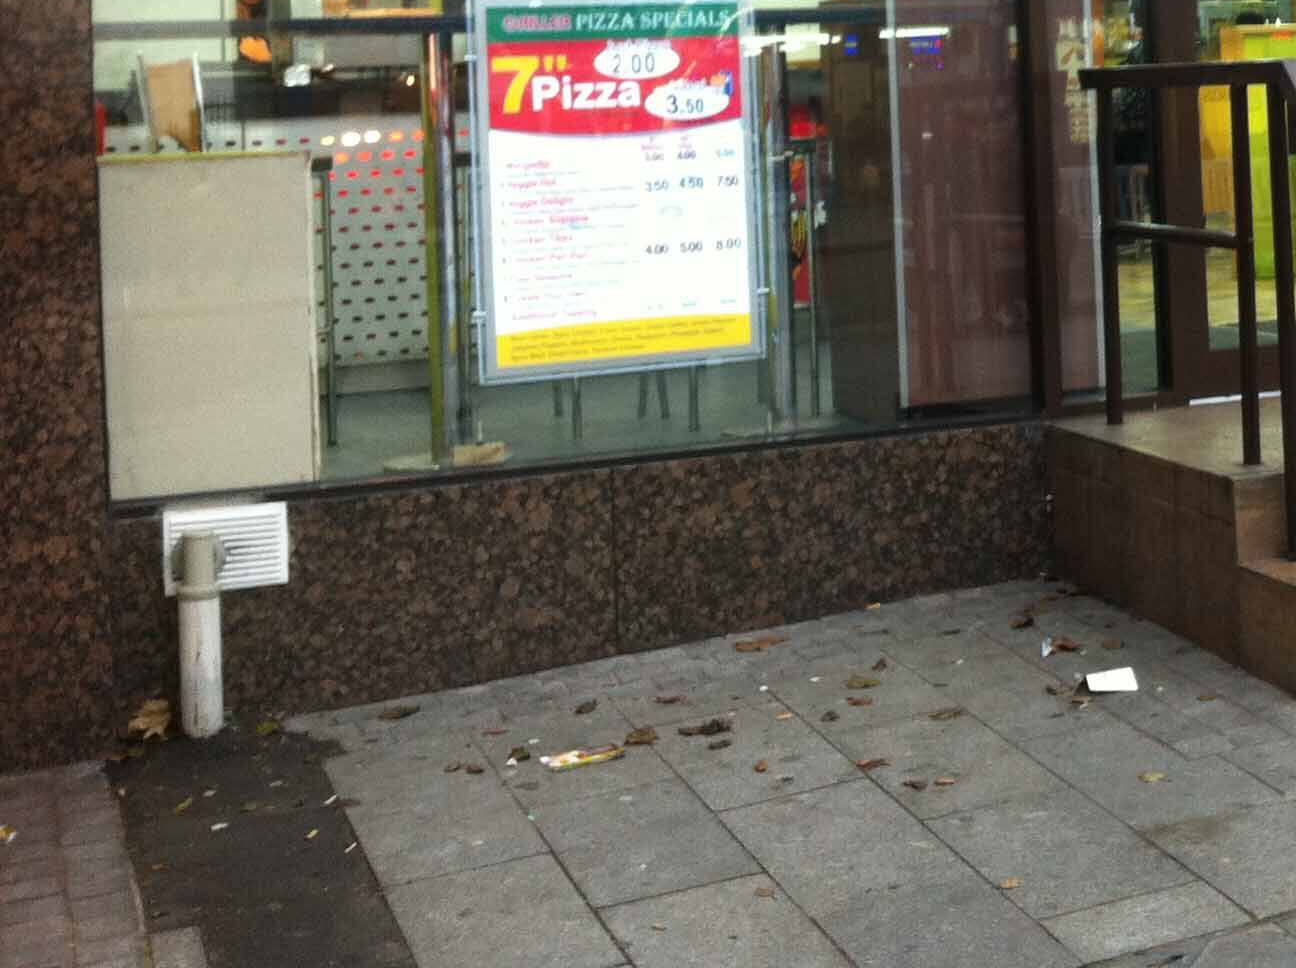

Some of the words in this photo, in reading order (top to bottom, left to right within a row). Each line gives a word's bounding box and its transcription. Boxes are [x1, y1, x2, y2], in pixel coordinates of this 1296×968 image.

[576, 10, 636, 31] PIZZA
[641, 8, 729, 30] SPECIALS
[531, 75, 641, 111] Pizza
[667, 94, 704, 114] 3.50
